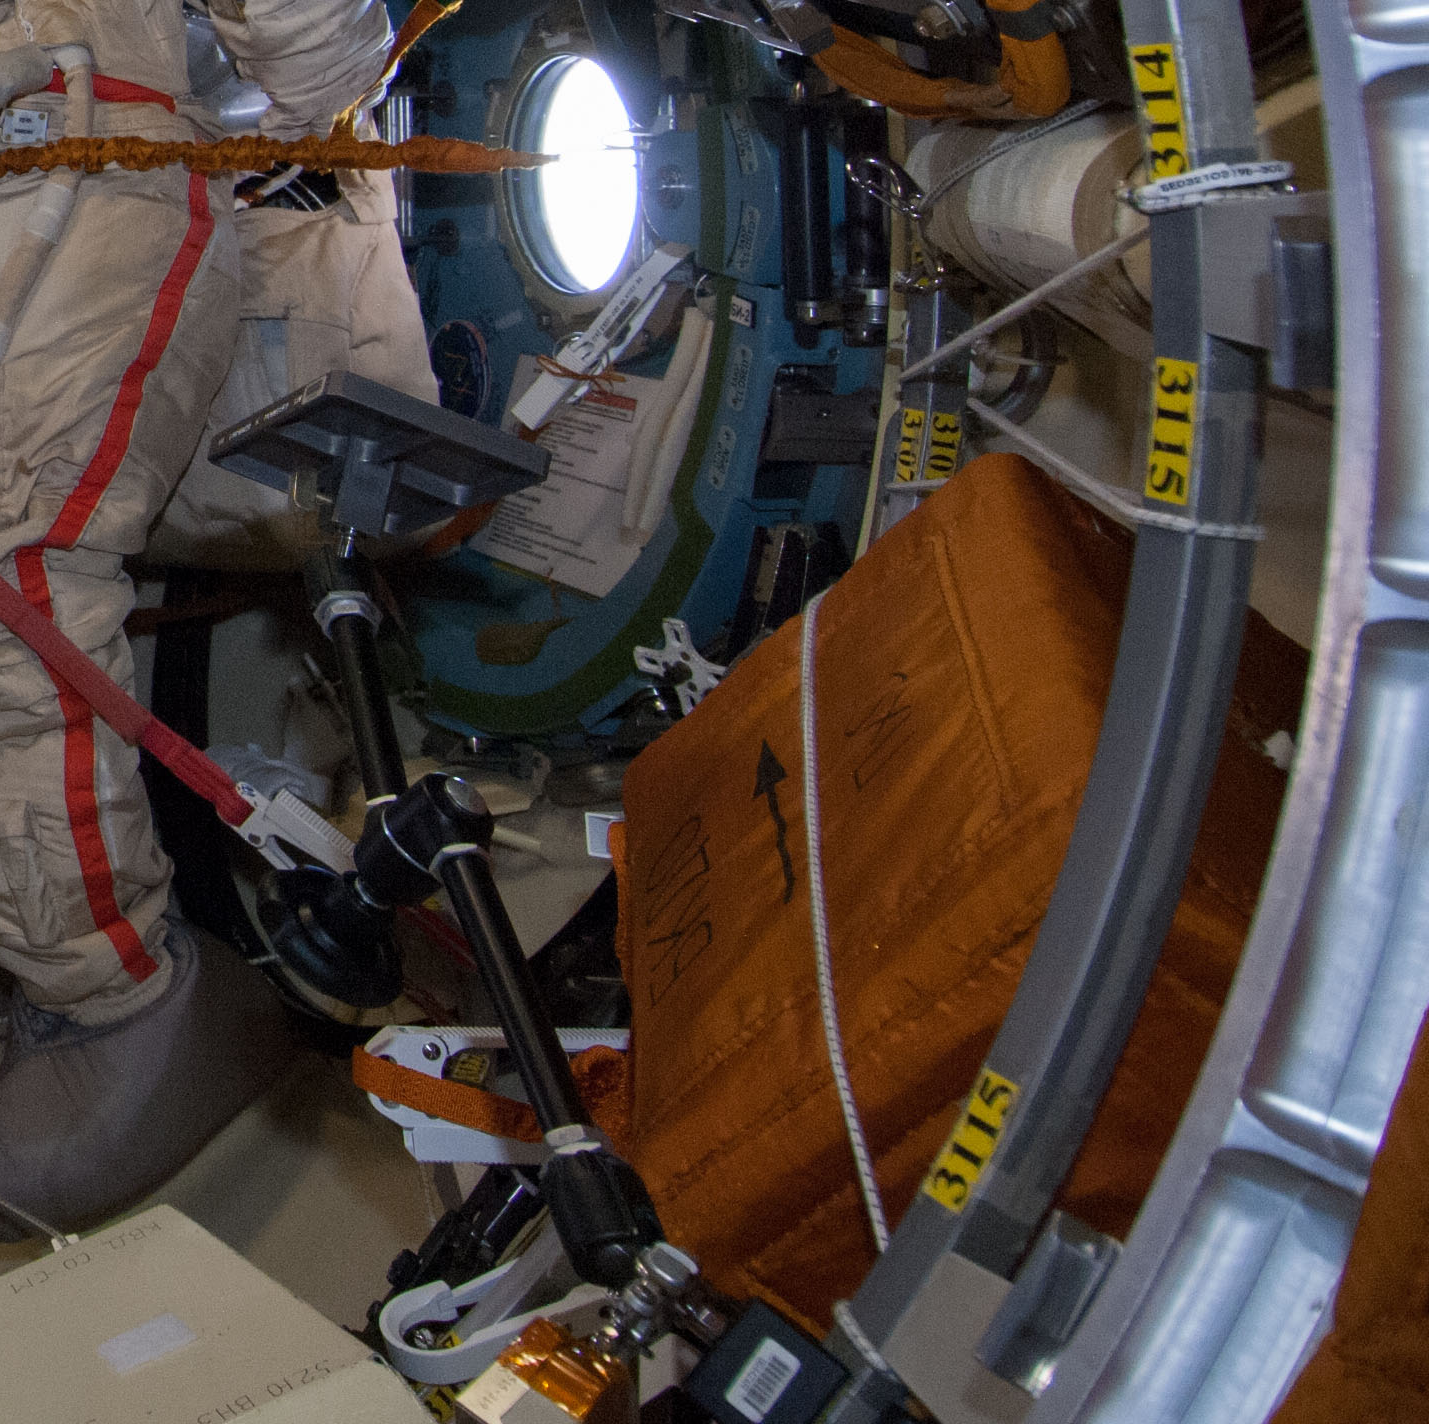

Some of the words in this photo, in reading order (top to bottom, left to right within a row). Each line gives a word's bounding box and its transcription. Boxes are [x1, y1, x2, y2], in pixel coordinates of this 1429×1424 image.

[1135, 49, 1187, 178] 3114
[929, 415, 960, 474] 310
[1150, 364, 1192, 498] 3115
[933, 1076, 1012, 1205] 3115
